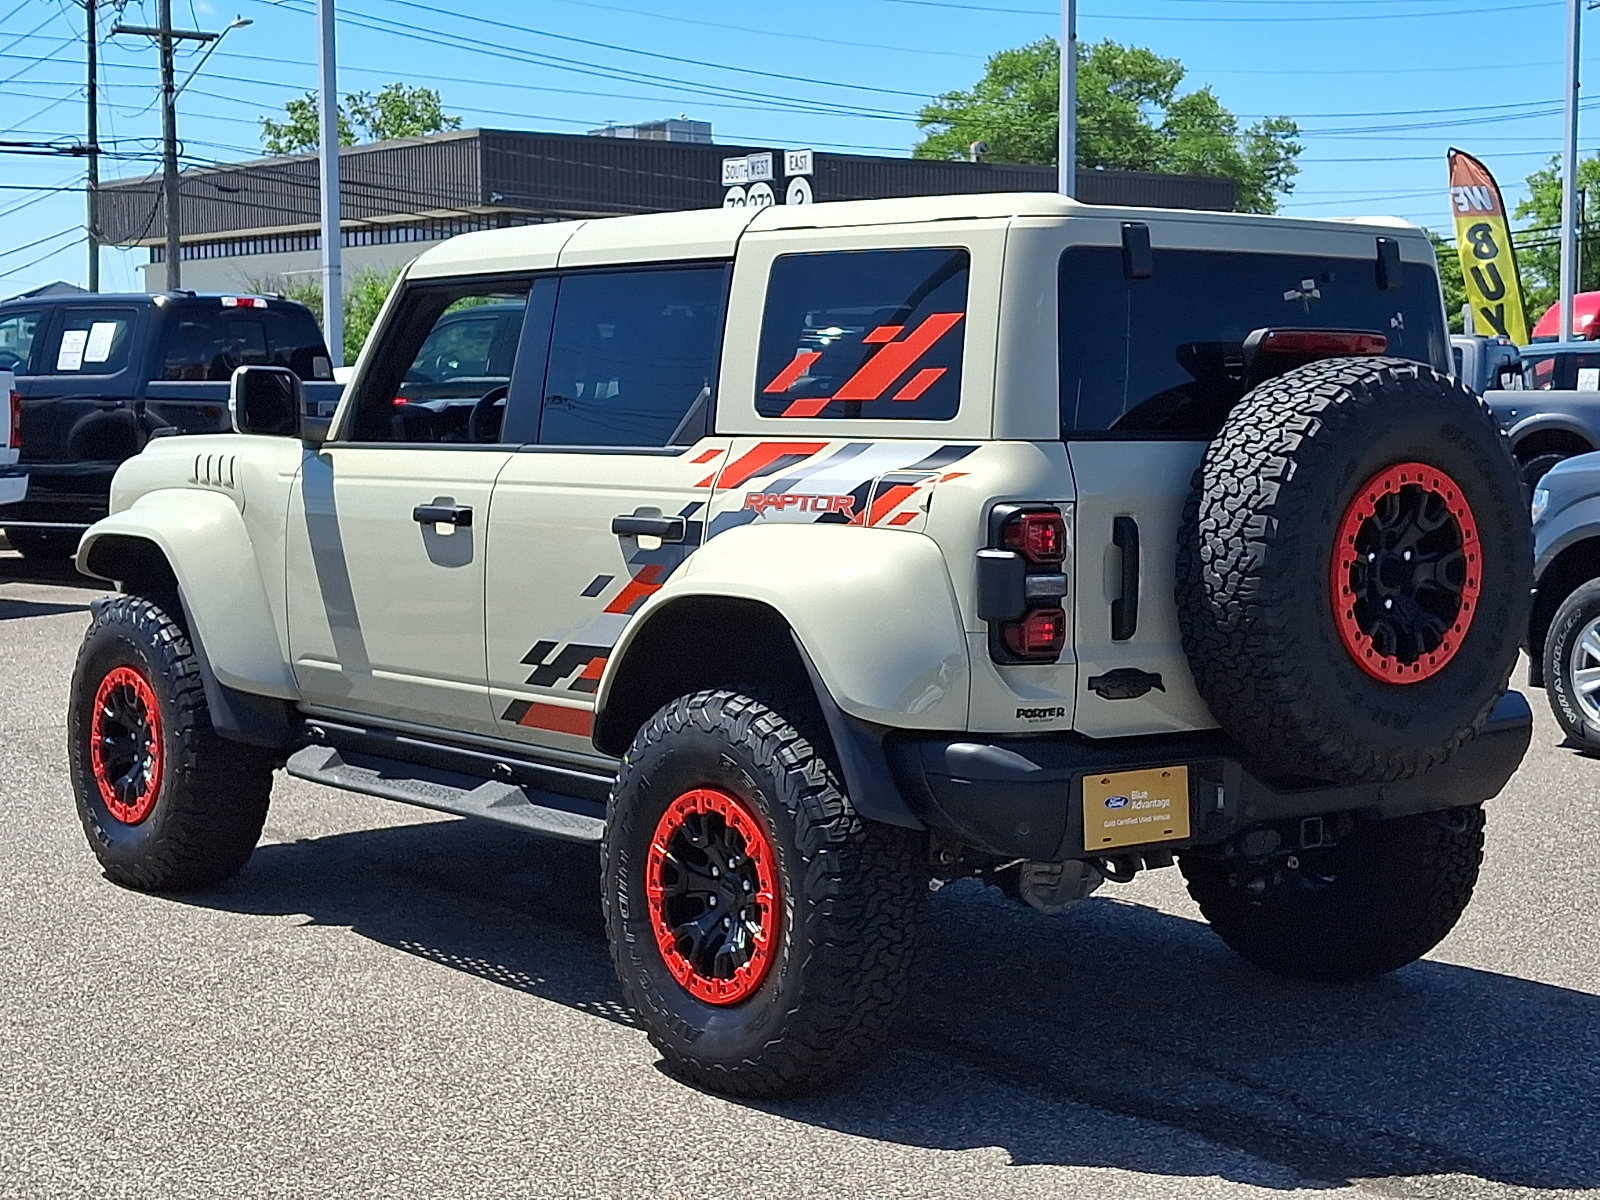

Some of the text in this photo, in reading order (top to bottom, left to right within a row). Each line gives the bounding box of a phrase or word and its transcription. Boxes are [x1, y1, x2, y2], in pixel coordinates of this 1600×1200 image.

[750, 159, 769, 175] WEST
[789, 155, 807, 171] EAST
[725, 164, 748, 180] SOUTH
[744, 492, 857, 522] RAPTOR
[1553, 608, 1582, 724] WRANGLER
[1016, 707, 1065, 718] PORTER
[1131, 790, 1148, 800] Blue
[1131, 798, 1170, 810] Advantage
